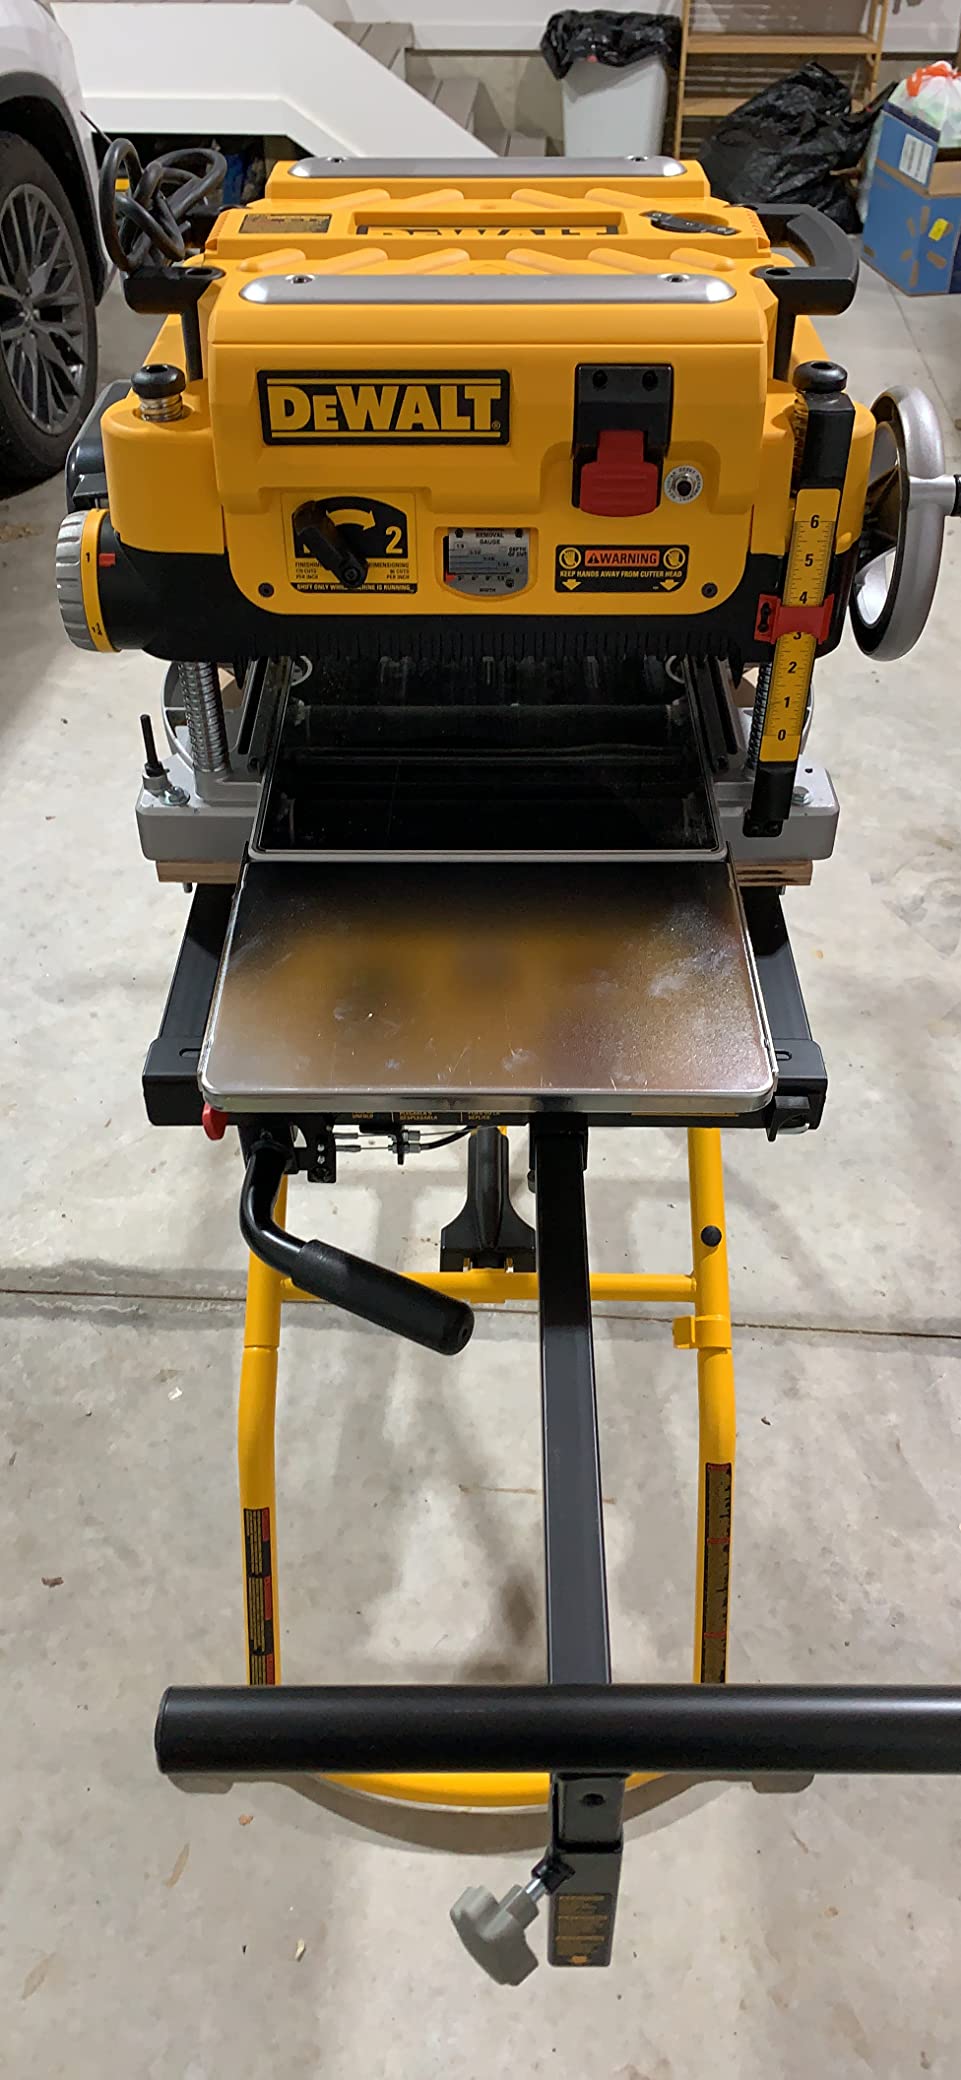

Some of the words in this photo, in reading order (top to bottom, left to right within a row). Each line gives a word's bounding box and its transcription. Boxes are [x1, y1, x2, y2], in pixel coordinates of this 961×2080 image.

[809, 514, 820, 529] 6
[385, 526, 403, 554] 2
[85, 552, 90, 562] 1
[600, 552, 657, 564] WARNING
[804, 553, 814, 567] 5
[560, 570, 577, 578] KEEP
[577, 570, 599, 578] HANDS
[600, 570, 620, 578] AWAY
[621, 570, 639, 578] FROM
[640, 570, 664, 578] CUTTER
[665, 570, 682, 578] HEAD
[799, 591, 808, 604] 4
[793, 632, 802, 640] 3
[787, 661, 797, 673] 2
[783, 697, 790, 708] 1
[777, 729, 787, 740] 0
